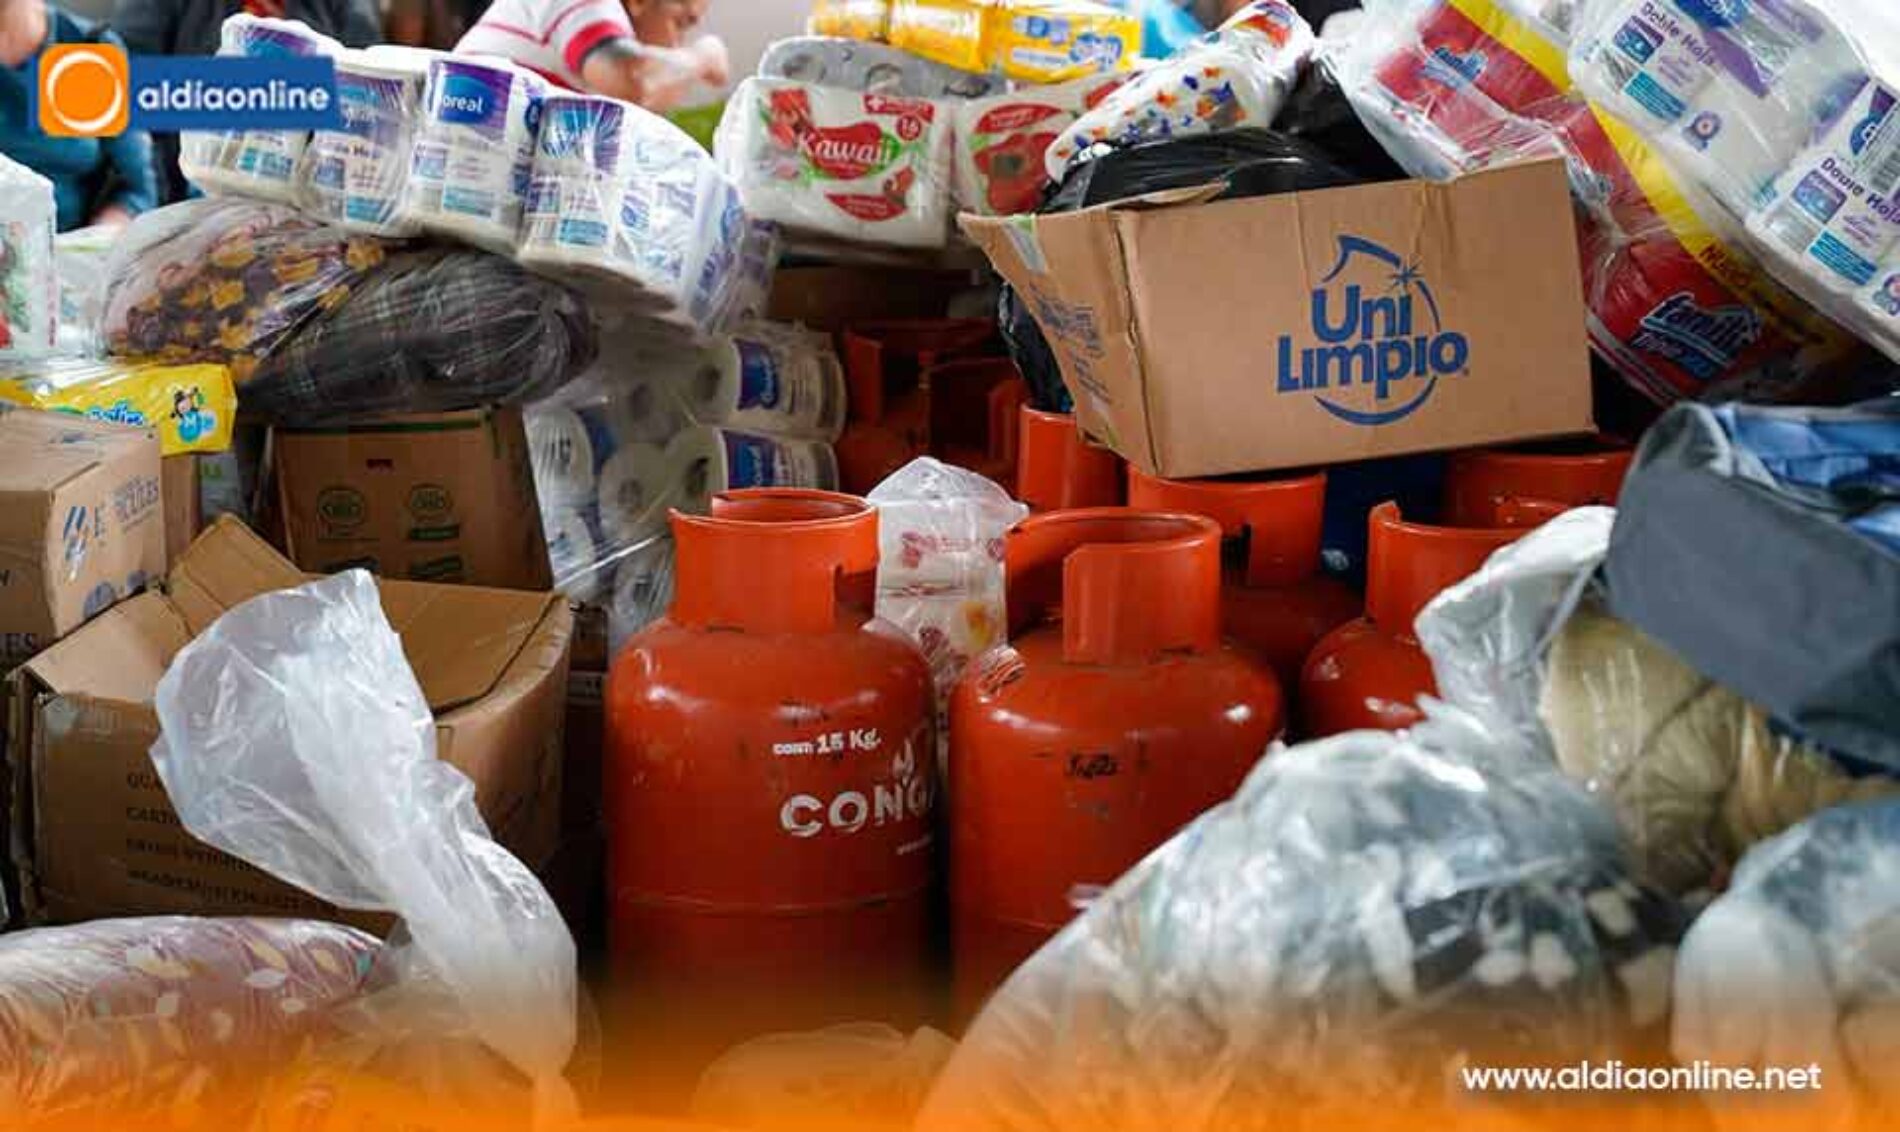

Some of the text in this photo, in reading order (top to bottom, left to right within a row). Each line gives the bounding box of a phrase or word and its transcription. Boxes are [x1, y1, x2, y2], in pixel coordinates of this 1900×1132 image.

[1311, 284, 1413, 343] Uni
[1277, 331, 1469, 399] Limpio
[817, 732, 844, 754] 15
